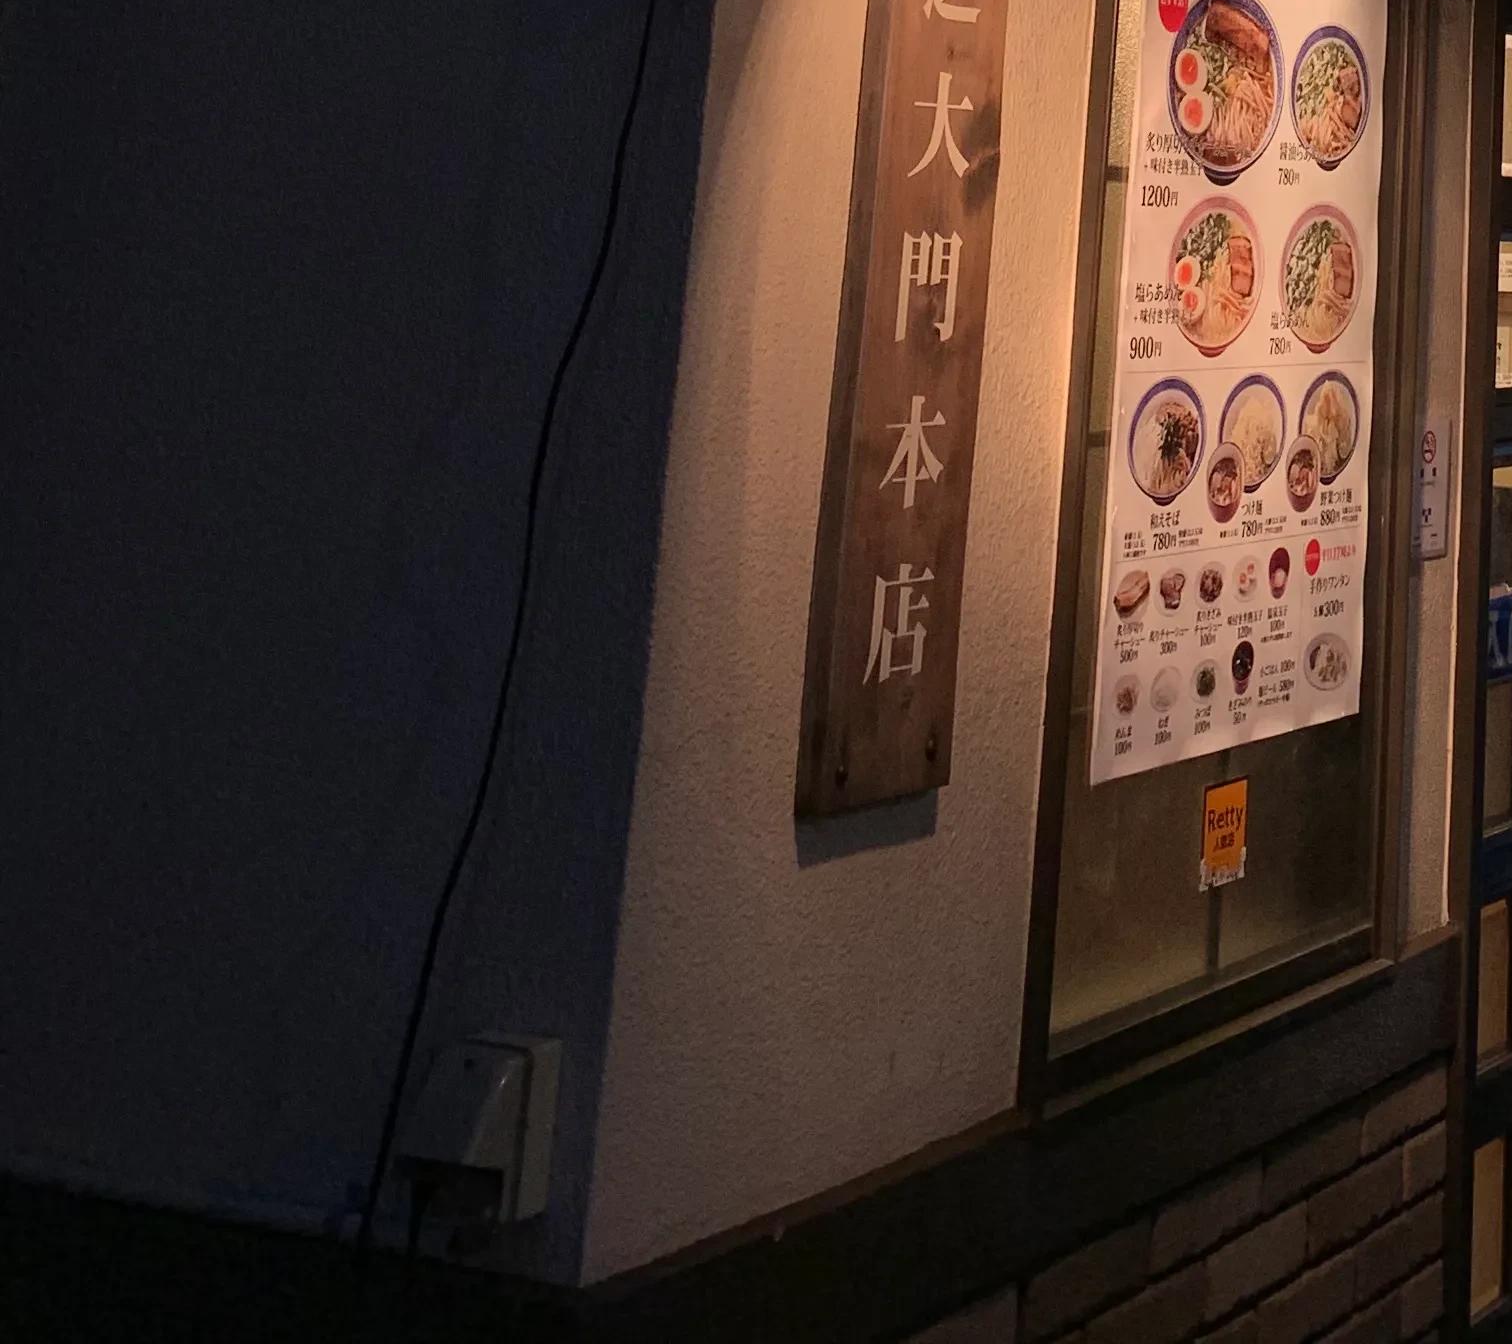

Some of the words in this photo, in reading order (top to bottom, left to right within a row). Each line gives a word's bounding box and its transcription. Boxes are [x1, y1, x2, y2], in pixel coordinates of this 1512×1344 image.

[1141, 185, 1179, 208] 1200円
[1130, 336, 1162, 359] 900円
[1152, 532, 1177, 551] 780円
[1207, 806, 1244, 833] Retty
